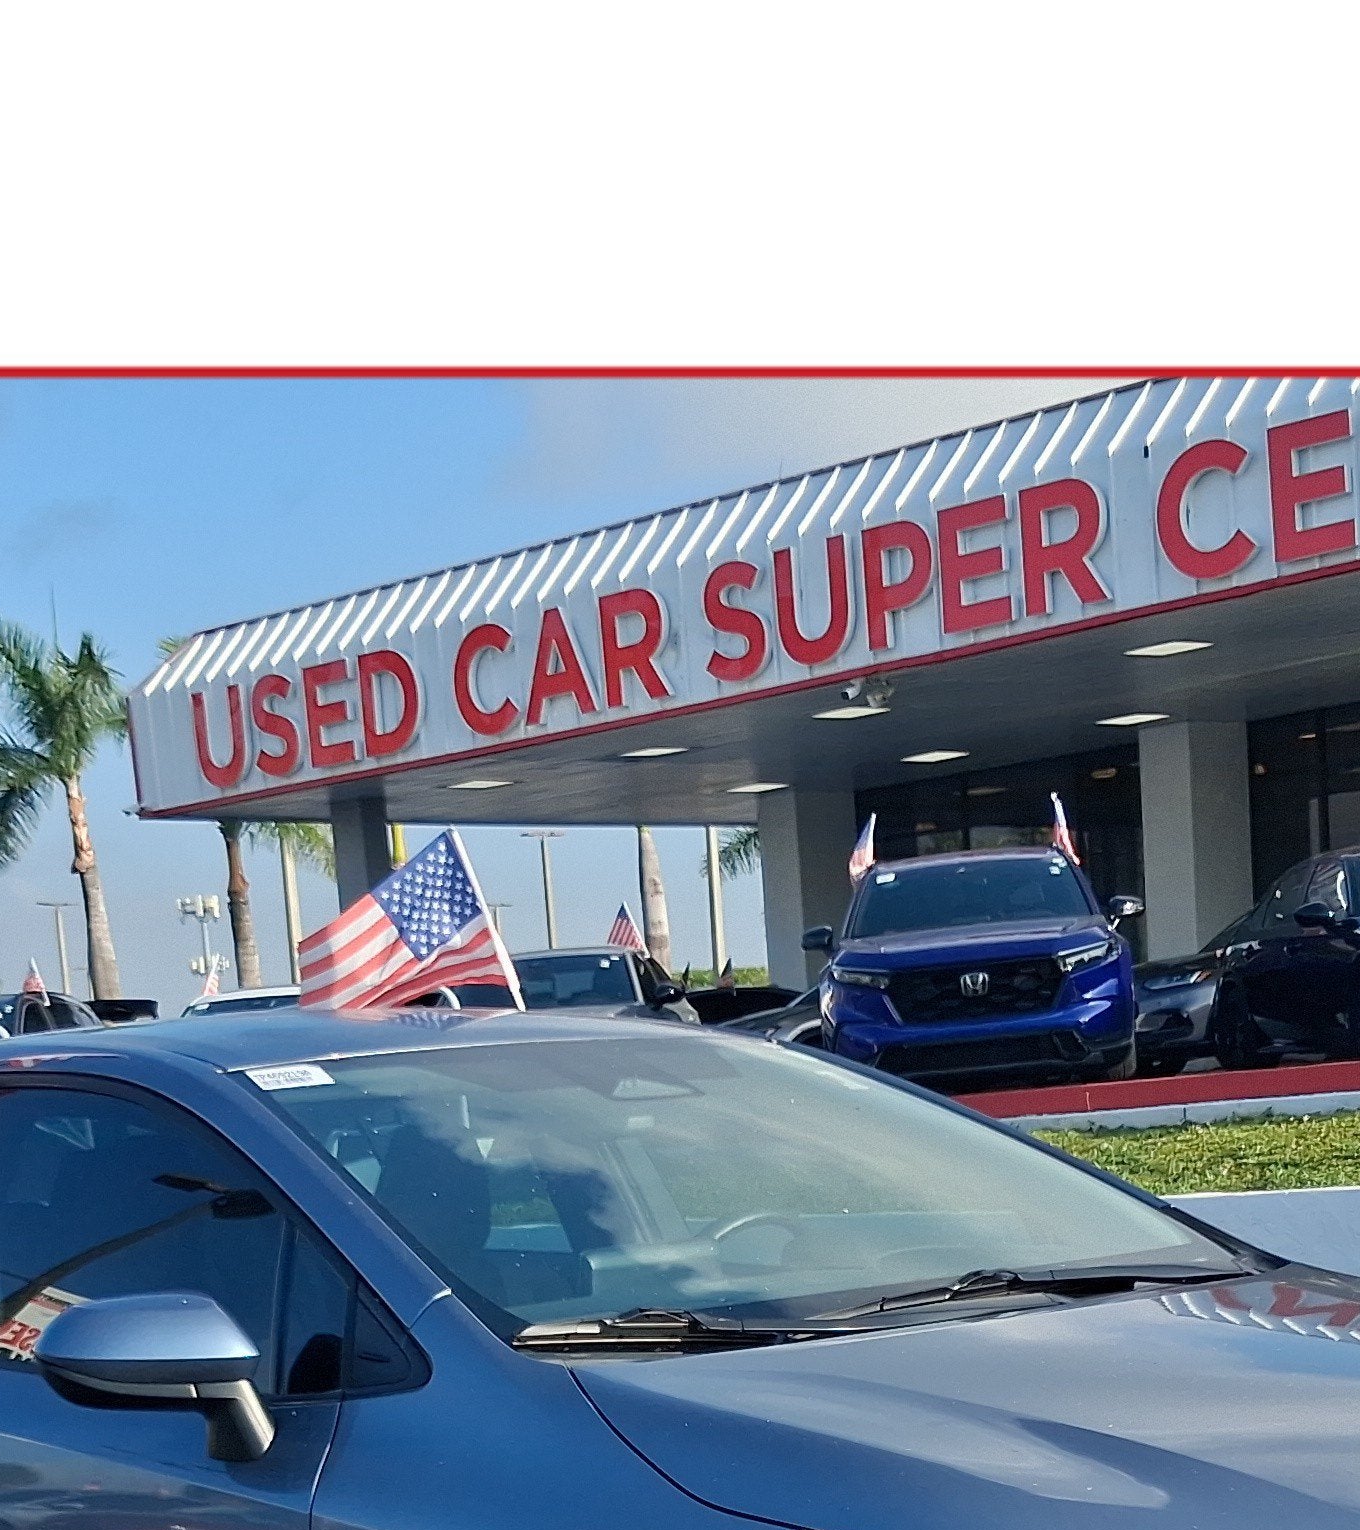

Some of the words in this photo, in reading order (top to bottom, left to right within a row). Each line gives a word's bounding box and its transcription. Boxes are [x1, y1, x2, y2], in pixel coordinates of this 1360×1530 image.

[190, 649, 419, 789] USED
[454, 588, 671, 736] CAR
[702, 478, 1111, 682] SUPER
